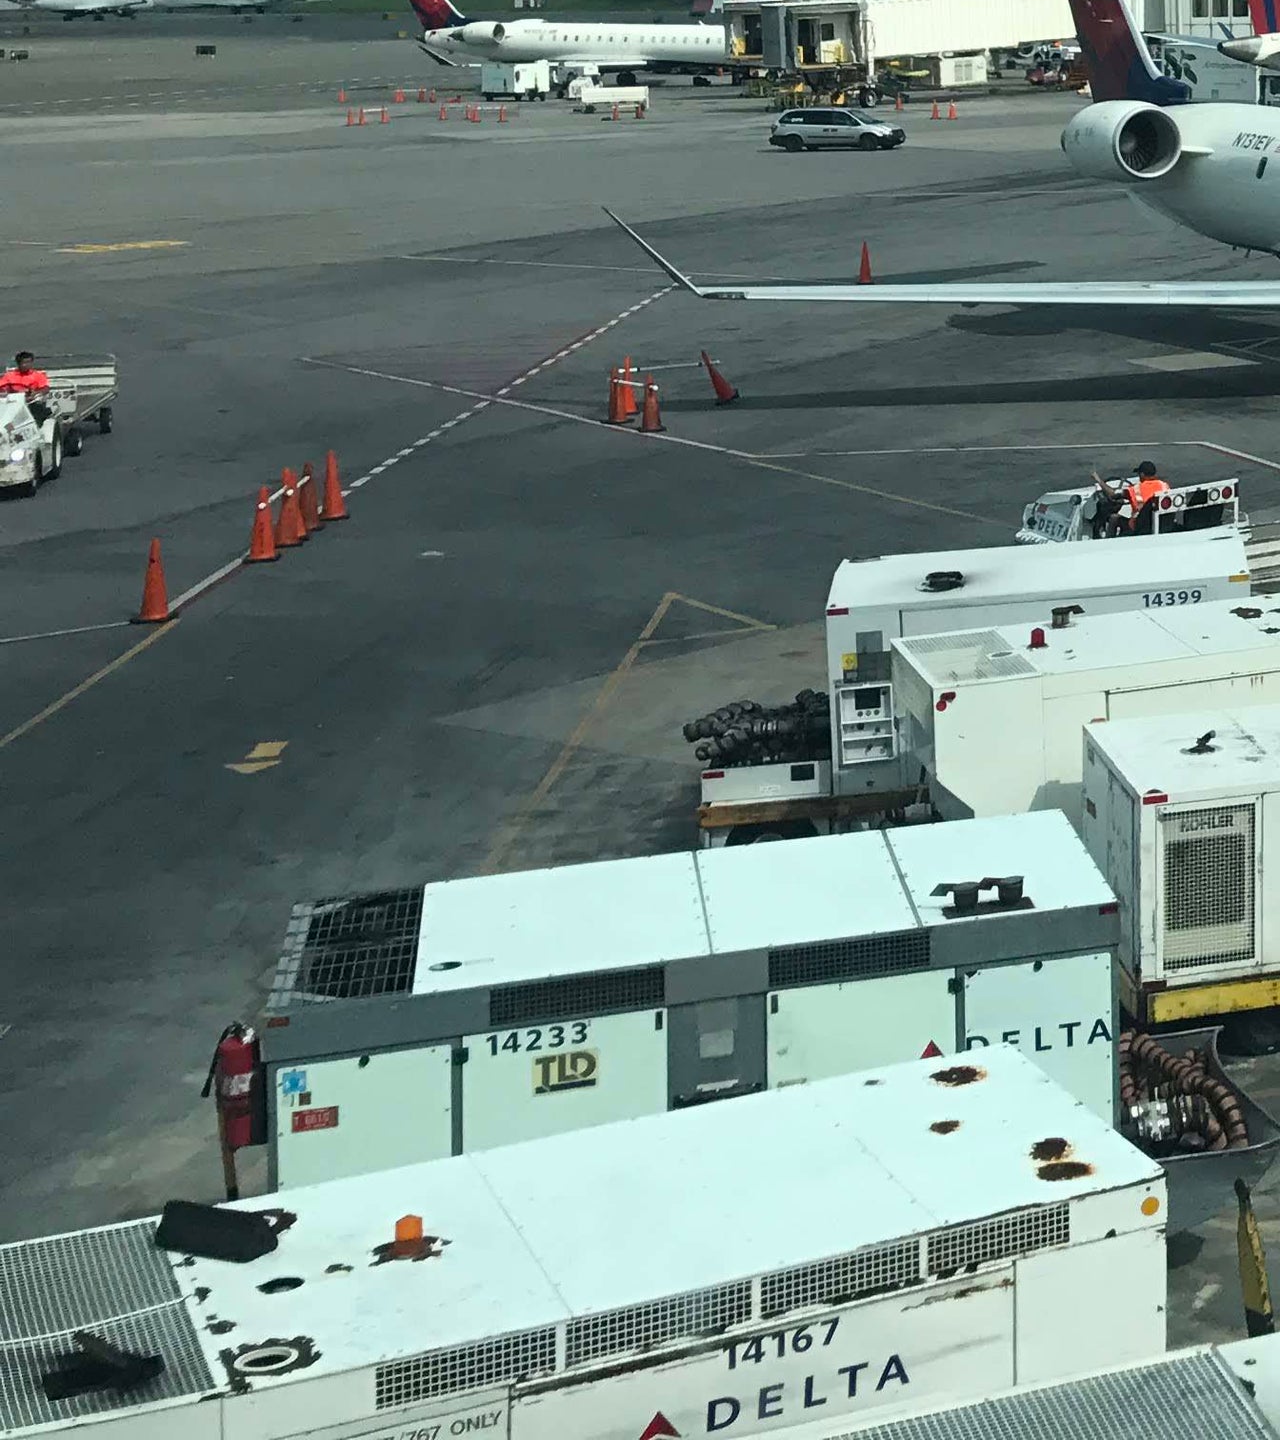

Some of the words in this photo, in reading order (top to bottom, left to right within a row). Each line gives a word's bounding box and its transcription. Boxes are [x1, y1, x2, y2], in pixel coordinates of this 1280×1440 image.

[1231, 131, 1276, 151] N131EV
[1038, 519, 1068, 539] DELTA
[1142, 589, 1202, 608] 14399
[1180, 814, 1234, 833] KOHLER
[486, 1022, 588, 1056] 14233
[535, 1051, 597, 1092] TLD
[723, 1316, 840, 1371] 14167
[706, 1354, 910, 1433] DELTA
[450, 1410, 502, 1436] ONLY
